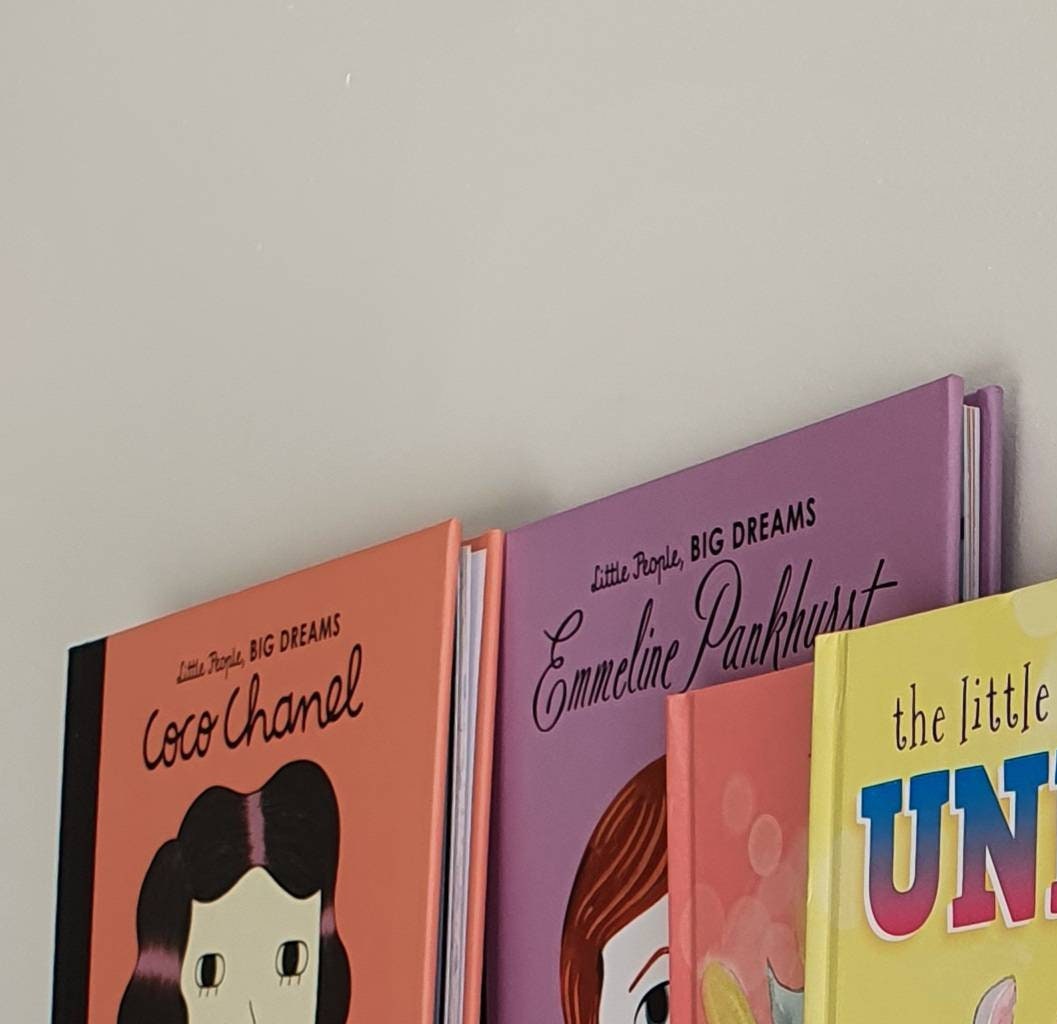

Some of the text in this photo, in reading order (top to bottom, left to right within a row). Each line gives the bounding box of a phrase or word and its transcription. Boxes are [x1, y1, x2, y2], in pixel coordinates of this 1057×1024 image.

[590, 497, 816, 593] Little People, BIG DREAMS
[249, 633, 274, 662] BIG
[279, 612, 341, 652] DREAMS
[532, 598, 680, 733] Emmeline
[142, 643, 364, 771] Coco Chanel
[893, 662, 1051, 752] the little
